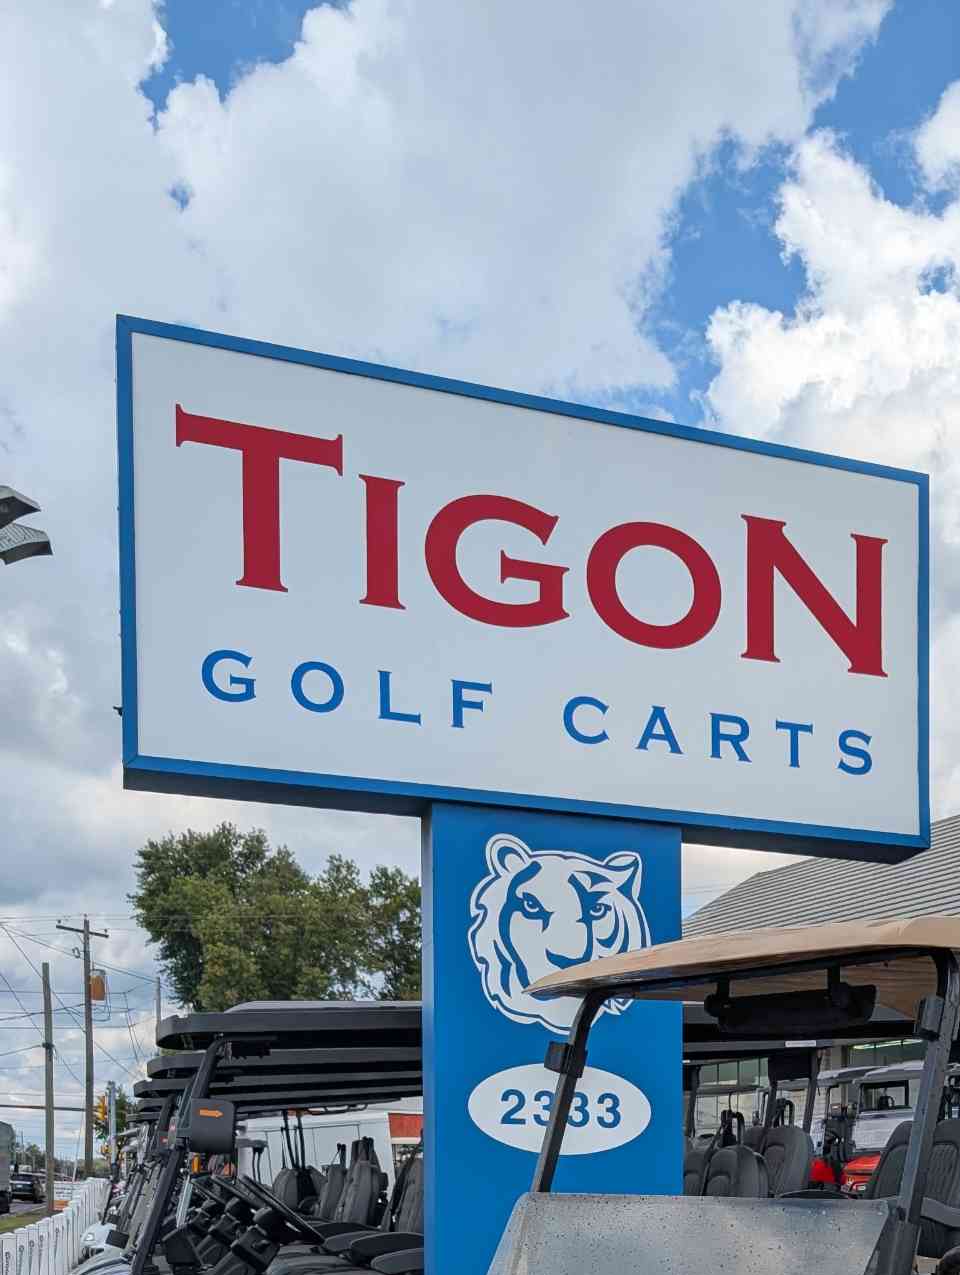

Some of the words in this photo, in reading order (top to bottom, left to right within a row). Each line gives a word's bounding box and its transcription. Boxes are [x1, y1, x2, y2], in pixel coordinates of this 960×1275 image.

[175, 405, 888, 678] TIGON
[200, 648, 493, 730] GOLF
[563, 695, 874, 776] CARTS
[499, 1088, 622, 1129] 2333
